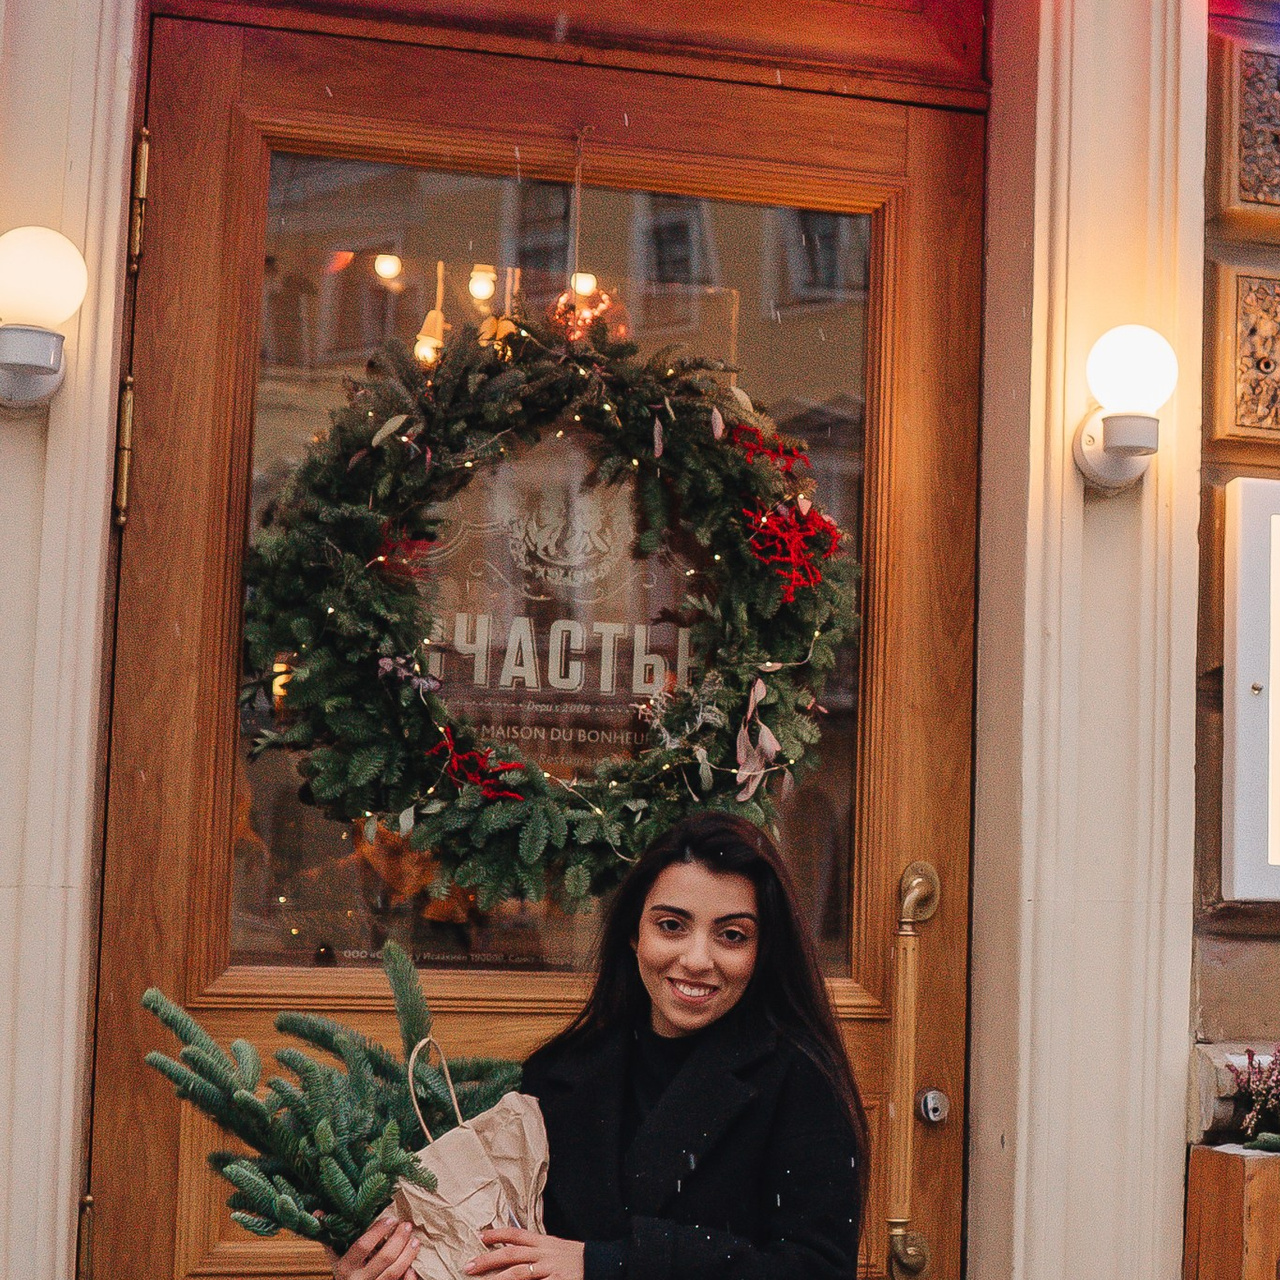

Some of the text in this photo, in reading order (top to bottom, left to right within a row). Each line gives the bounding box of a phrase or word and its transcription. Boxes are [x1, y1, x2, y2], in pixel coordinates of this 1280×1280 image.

[428, 611, 699, 698] ЧАСТЬ
[481, 723, 546, 741] MAISON
[550, 727, 573, 743] DU
[343, 949, 368, 960] ООО
